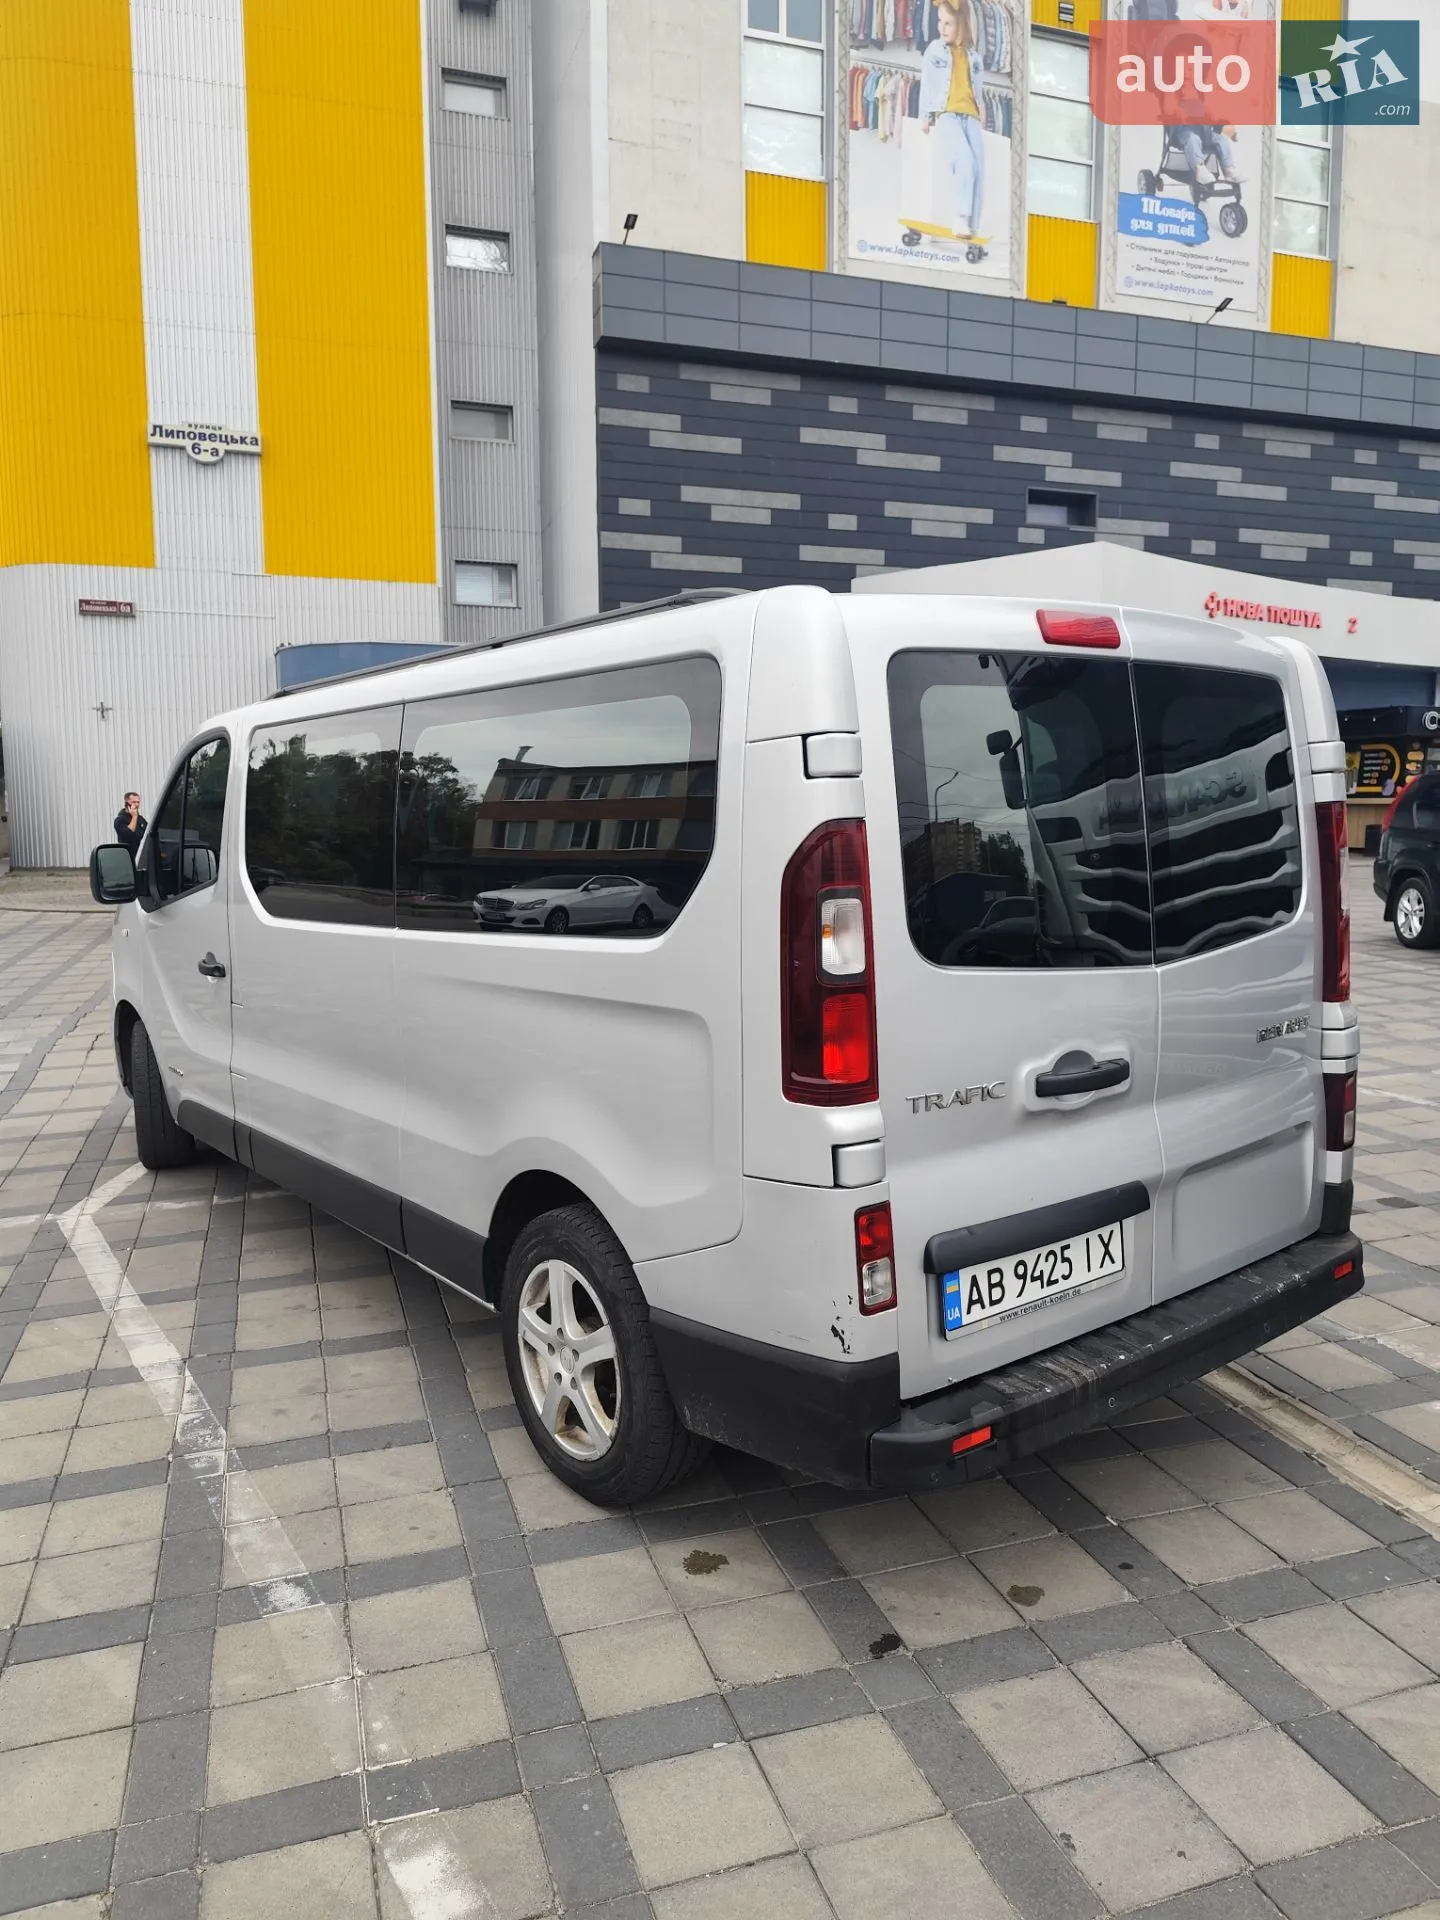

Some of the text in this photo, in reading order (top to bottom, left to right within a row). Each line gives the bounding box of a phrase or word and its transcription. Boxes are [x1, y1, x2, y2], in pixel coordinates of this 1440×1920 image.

[869, 244, 960, 262] www.lapkatoys.com
[1134, 279, 1213, 297] www.lapkatoys.com
[150, 424, 259, 446] Липовецька
[191, 443, 219, 457] 6-а
[1224, 598, 1359, 633] НОВА ПОШТА 2
[905, 1080, 1006, 1115] TRAFIC
[966, 1267, 1006, 1315] AB
[1014, 1244, 1073, 1298] 9425
[947, 1309, 961, 1321] UA
